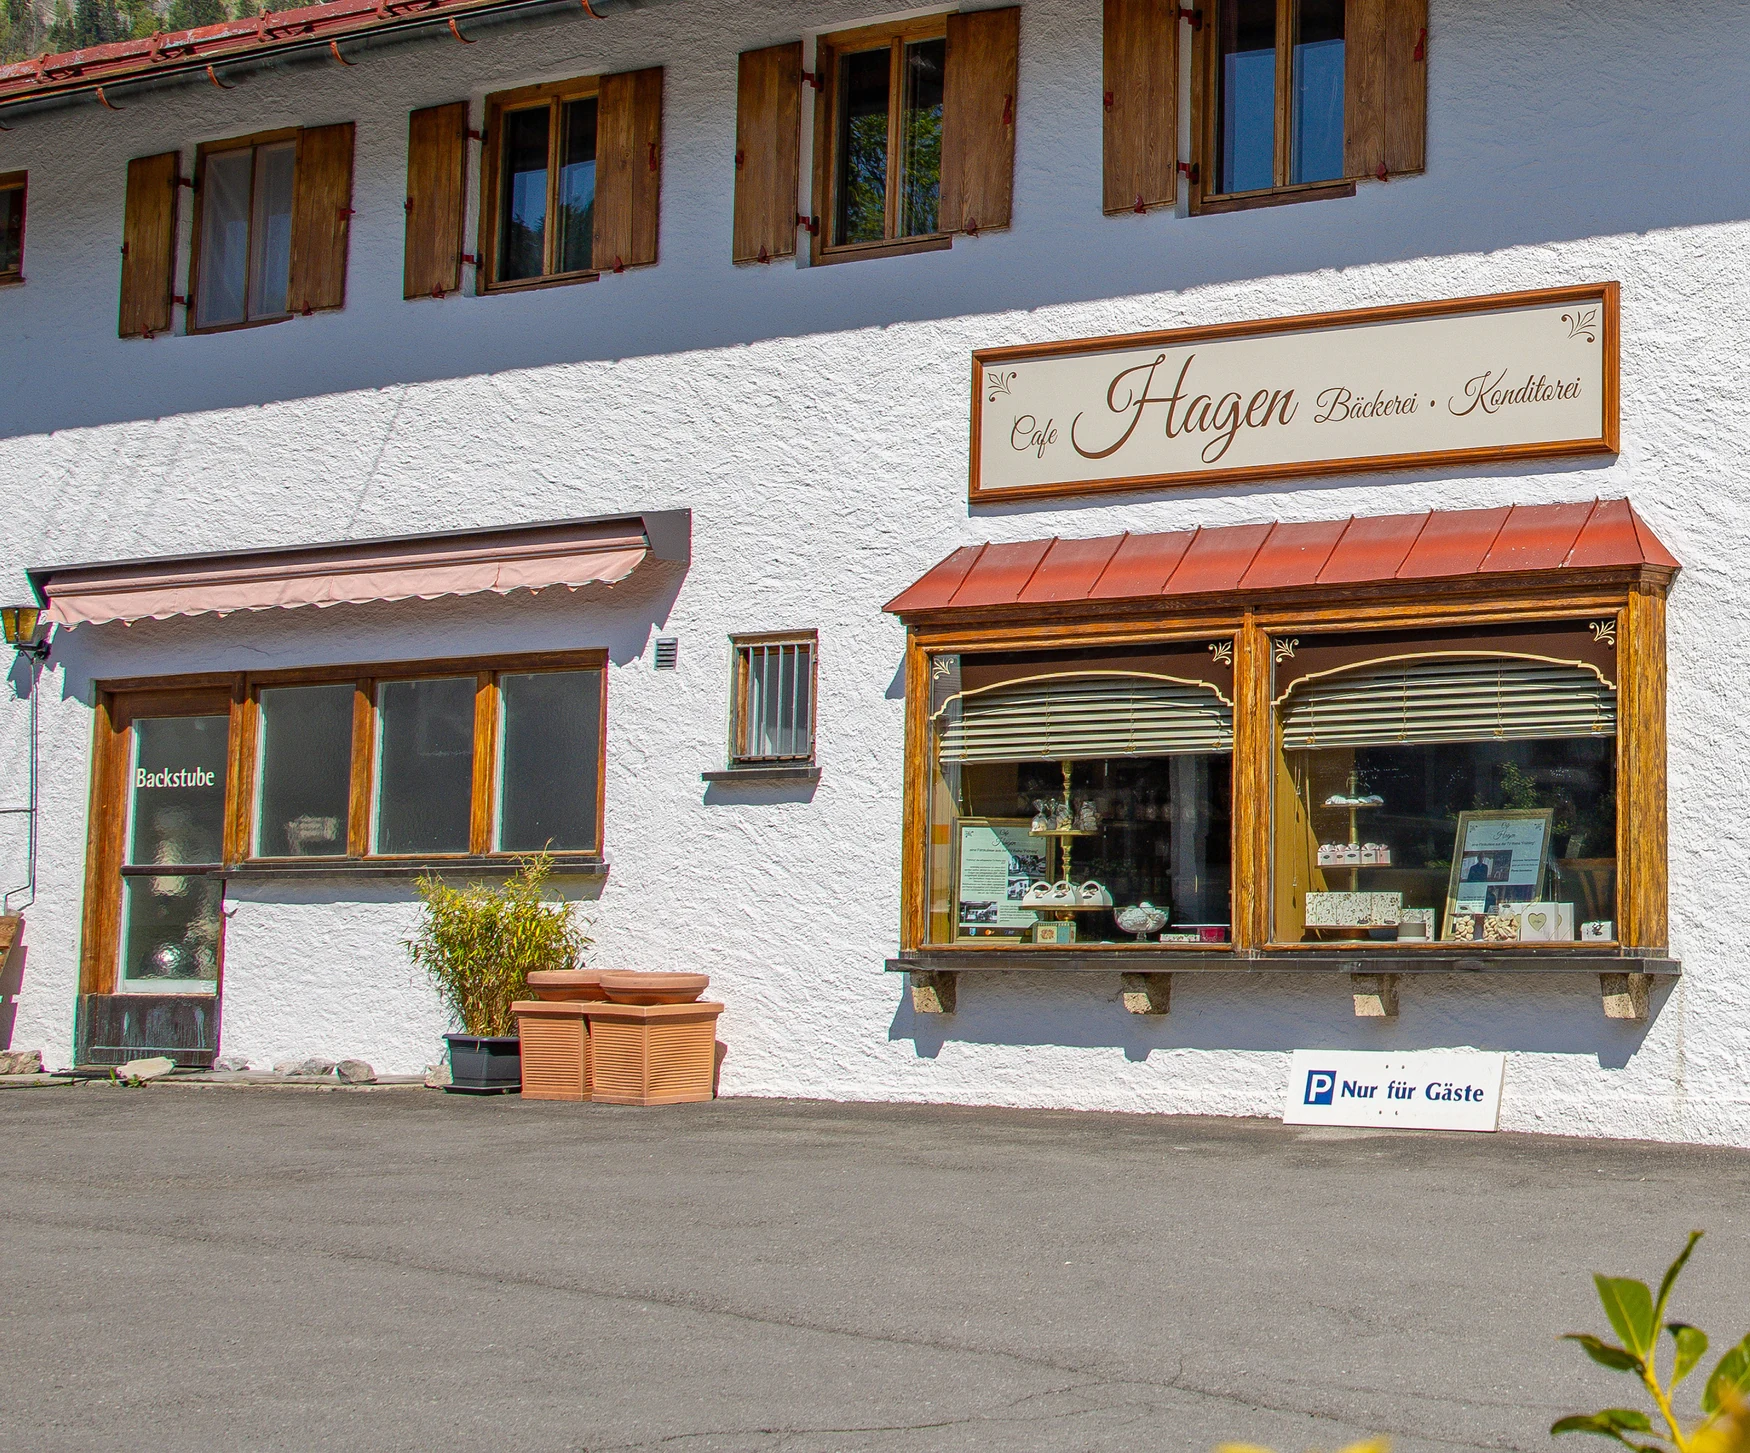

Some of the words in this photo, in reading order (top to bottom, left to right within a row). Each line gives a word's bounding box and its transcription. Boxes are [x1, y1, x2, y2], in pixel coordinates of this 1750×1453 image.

[1010, 414, 1058, 459] Cafe
[1071, 353, 1299, 464] Hagen
[1314, 386, 1419, 424] Bäckerei
[1448, 368, 1582, 416] Konditorei
[136, 766, 216, 788] Backstube
[1341, 1080, 1379, 1099] Nur
[1387, 1080, 1417, 1100] für
[1425, 1082, 1484, 1103] Gäste
